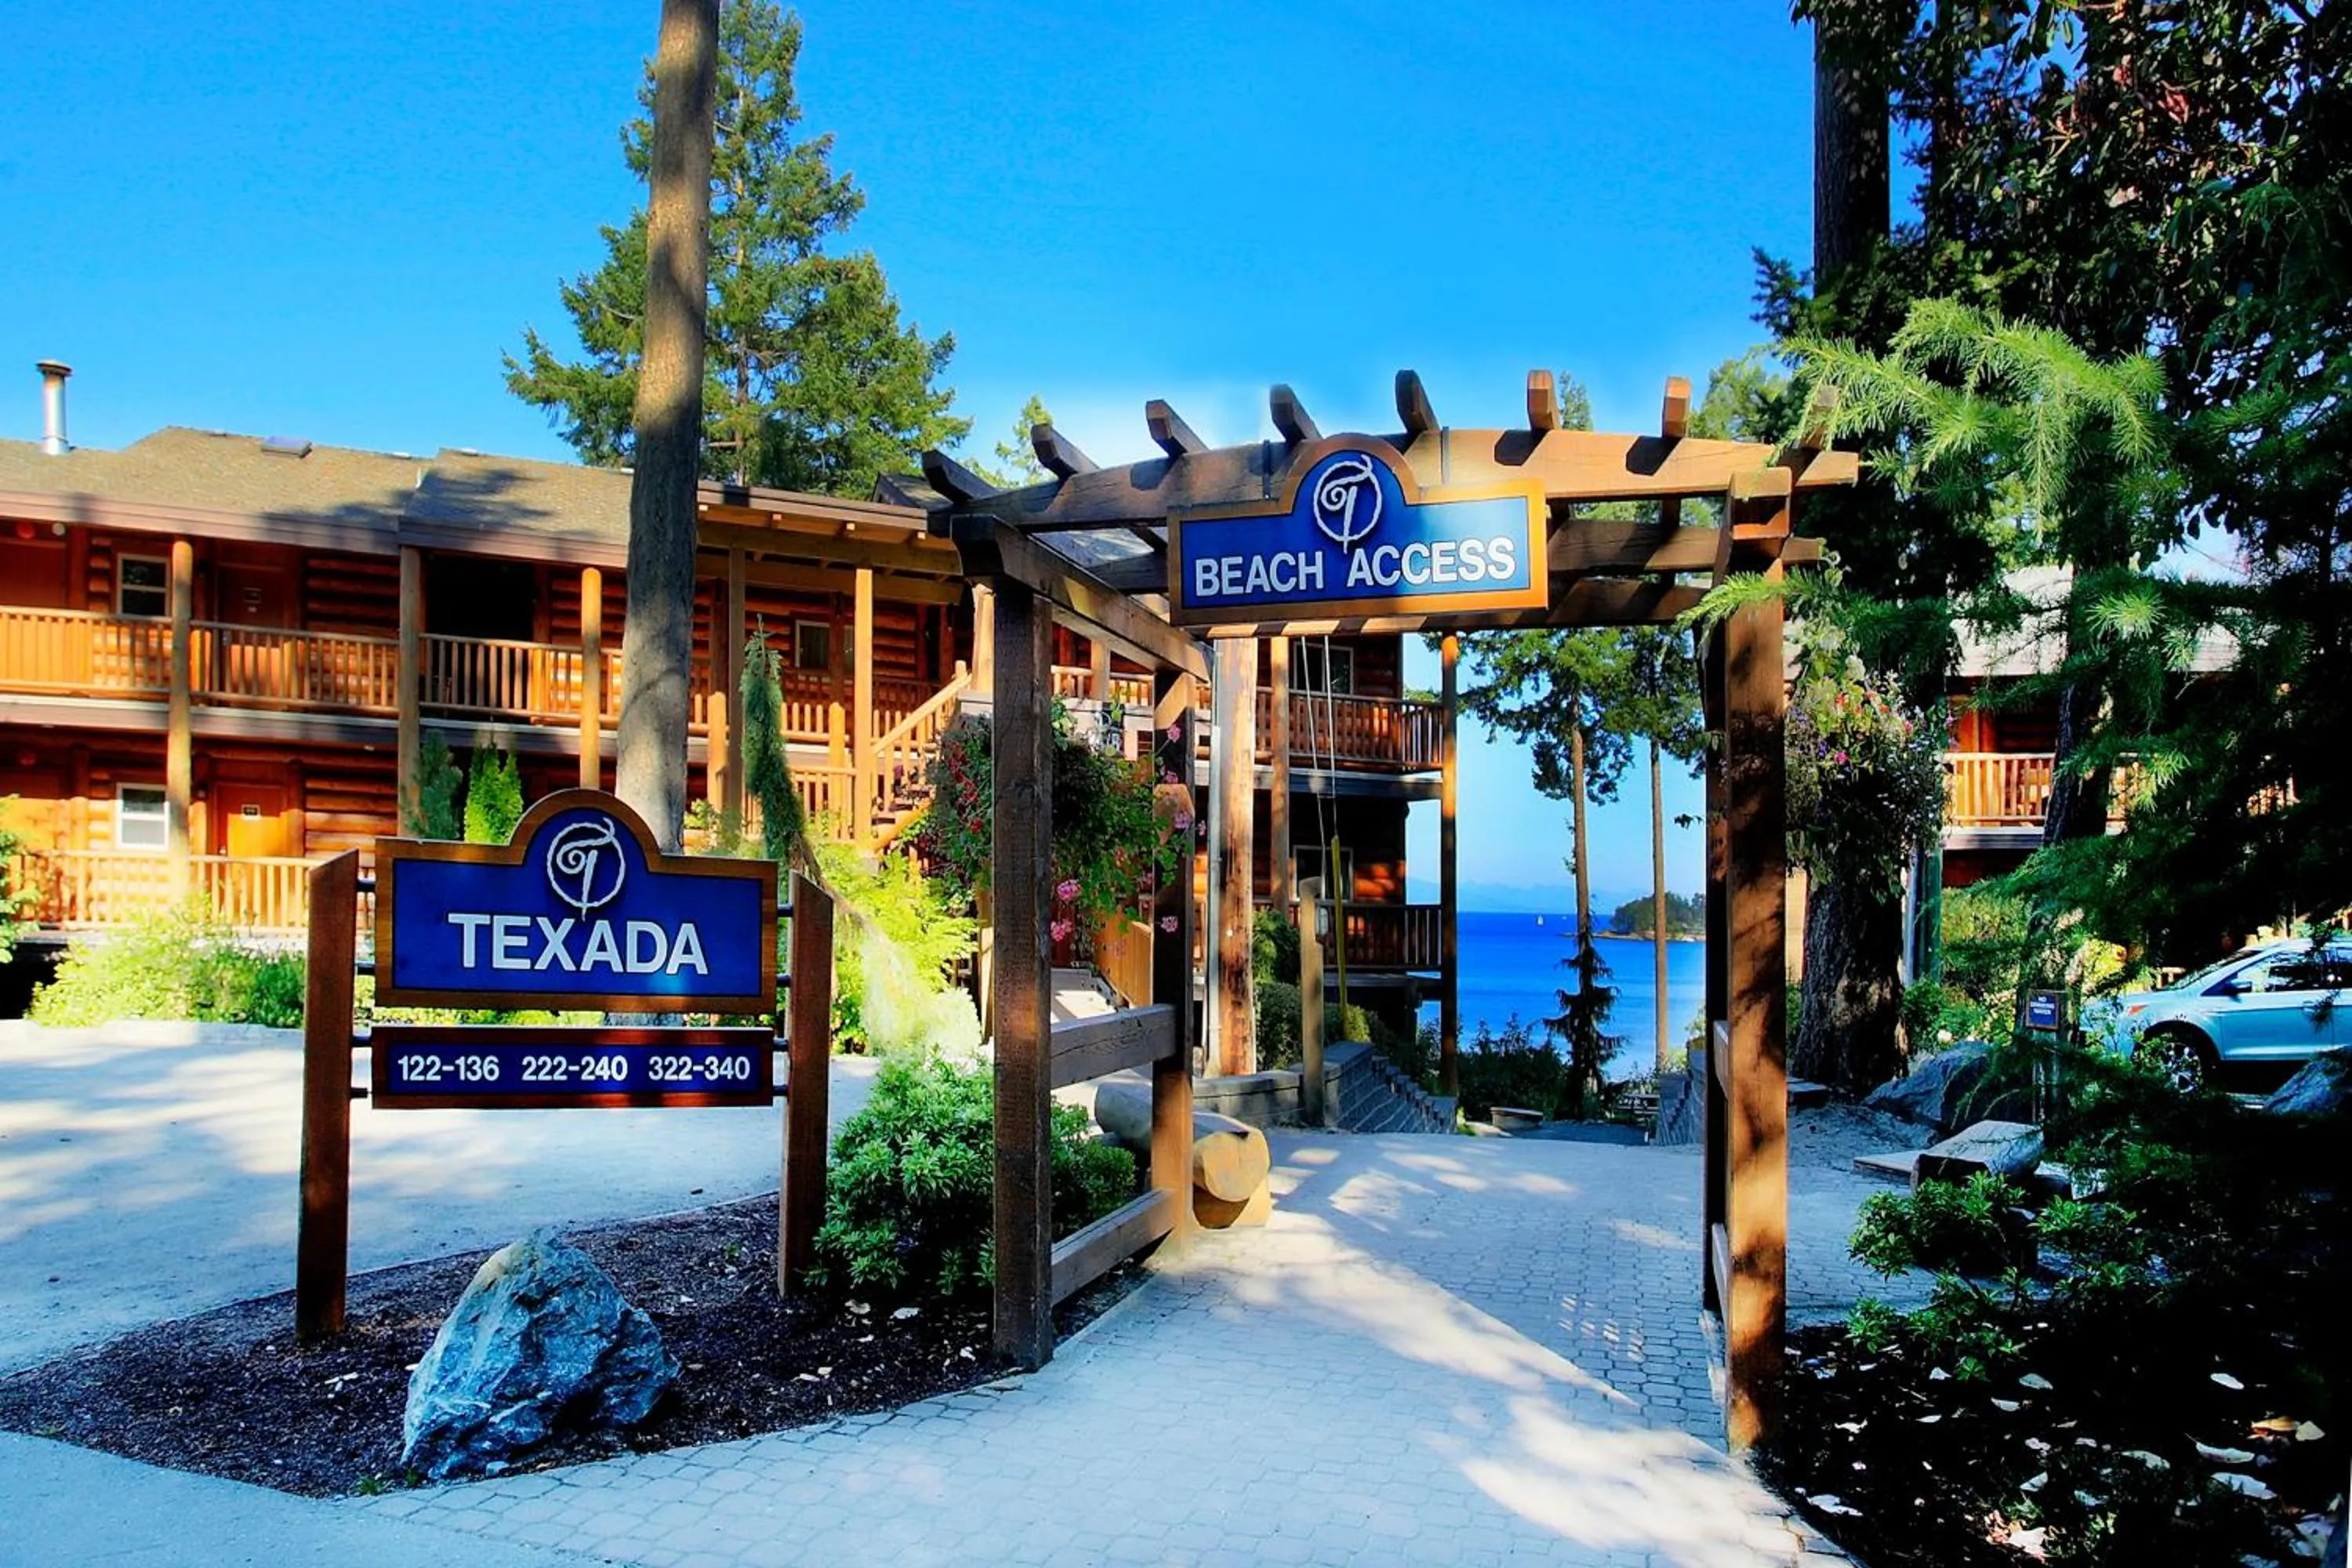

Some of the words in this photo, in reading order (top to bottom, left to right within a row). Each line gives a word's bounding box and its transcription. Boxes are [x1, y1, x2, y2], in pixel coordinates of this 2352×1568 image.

[1195, 550, 1323, 597] BEACH
[1346, 536, 1516, 587] ACCESS
[448, 913, 709, 975] TEXADA
[397, 1054, 499, 1081] 122-136
[521, 1055, 628, 1081] 222-240
[648, 1055, 750, 1080] 322-340
